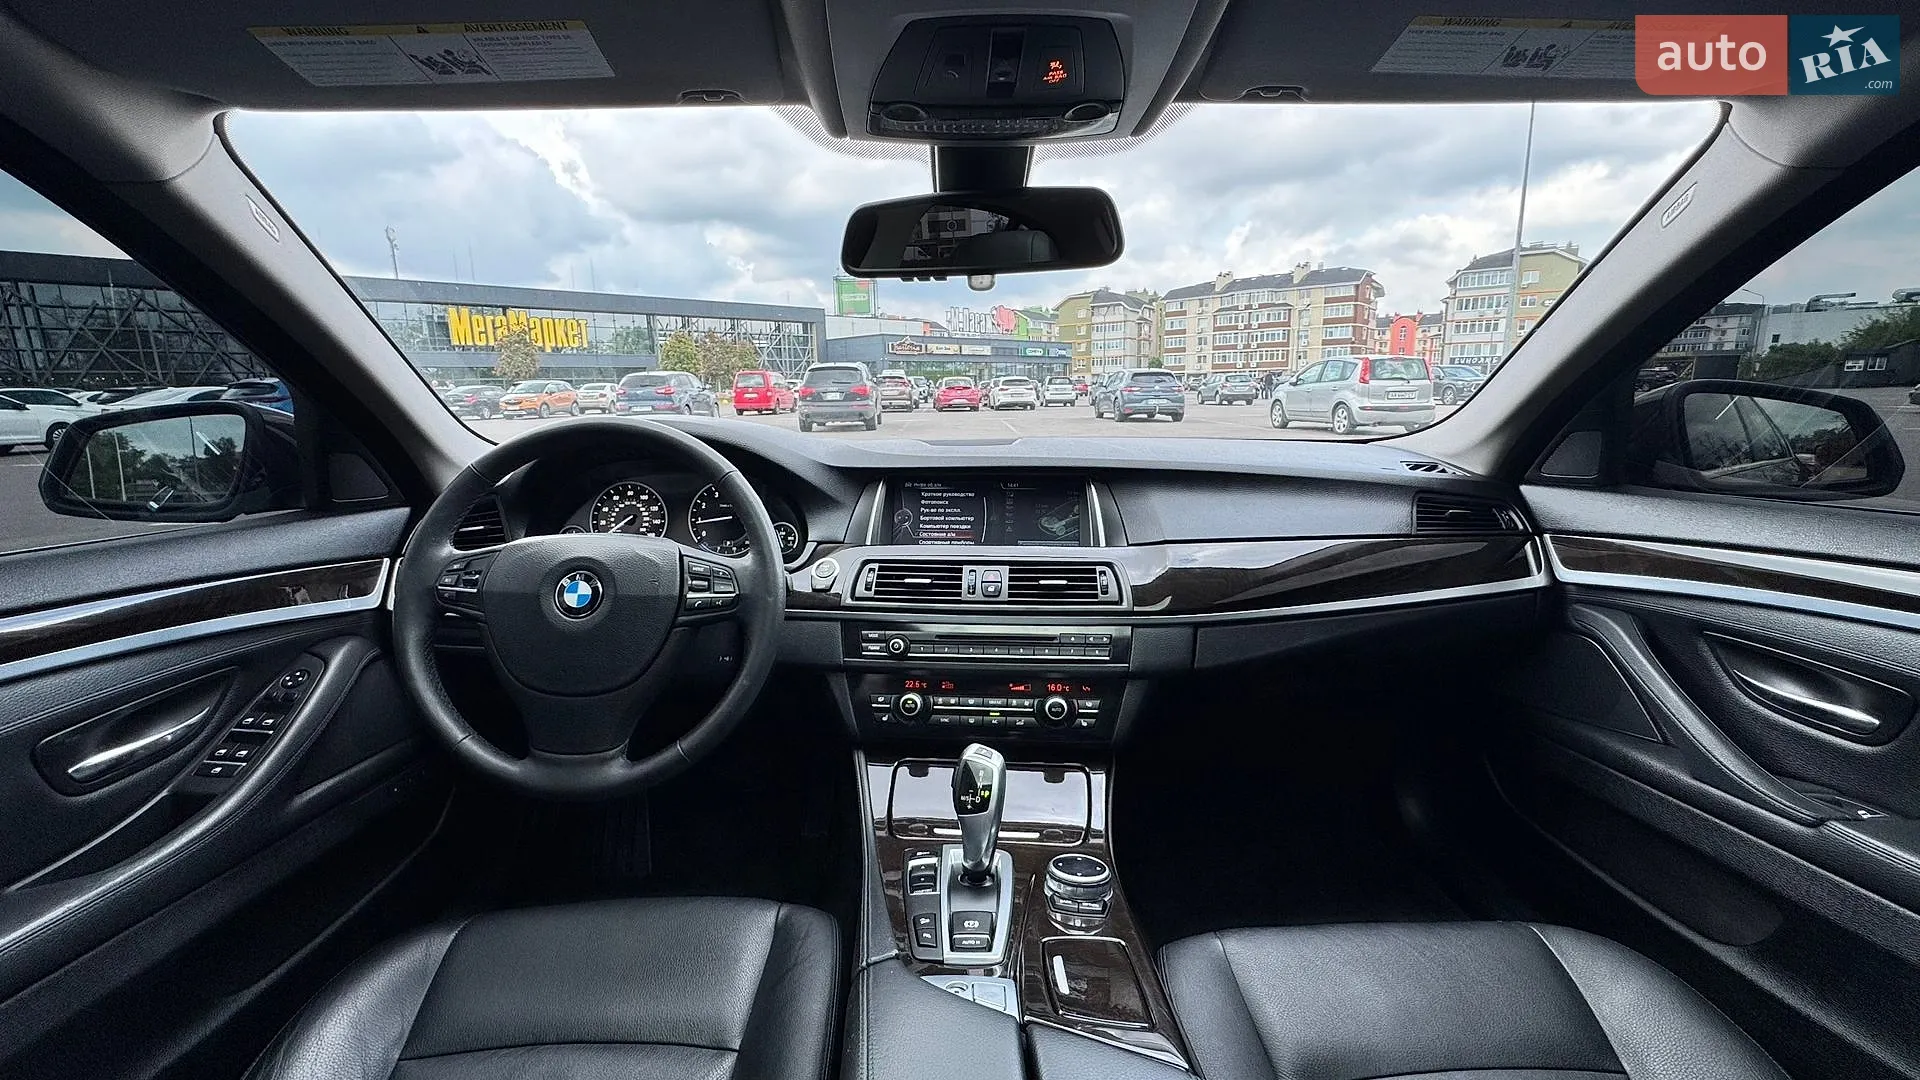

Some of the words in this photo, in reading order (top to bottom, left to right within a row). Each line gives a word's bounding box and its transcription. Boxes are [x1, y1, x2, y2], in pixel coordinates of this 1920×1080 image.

[464, 21, 570, 33] AVERTISSEMENT
[1443, 17, 1502, 27] WARNING
[280, 27, 350, 37] WARNING
[448, 306, 589, 353] МегаМаркет
[562, 573, 600, 588] BMW
[904, 680, 921, 688] 22.5
